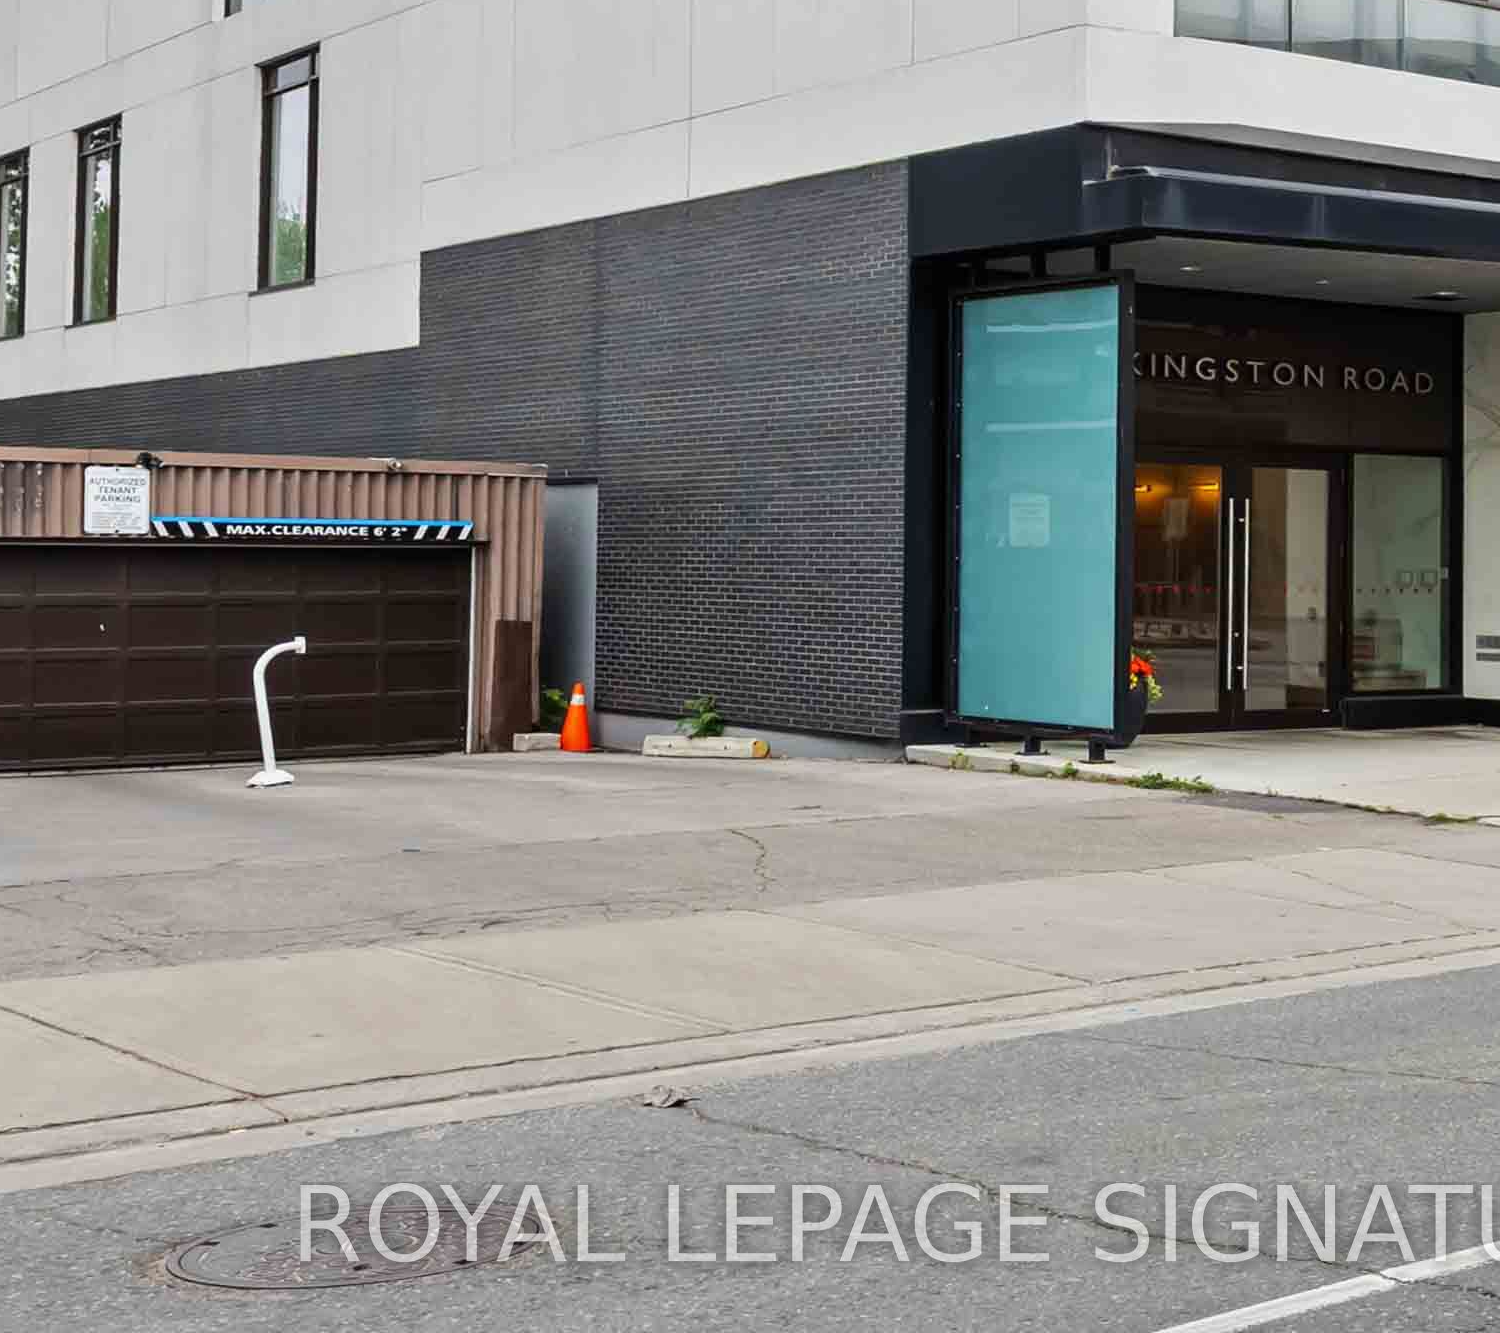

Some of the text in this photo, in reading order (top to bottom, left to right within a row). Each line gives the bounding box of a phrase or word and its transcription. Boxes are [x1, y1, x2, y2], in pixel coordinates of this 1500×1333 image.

[1344, 366, 1435, 394] ROAD
[100, 486, 137, 494] TENANT
[225, 524, 369, 537] MAX.CLEARANCE
